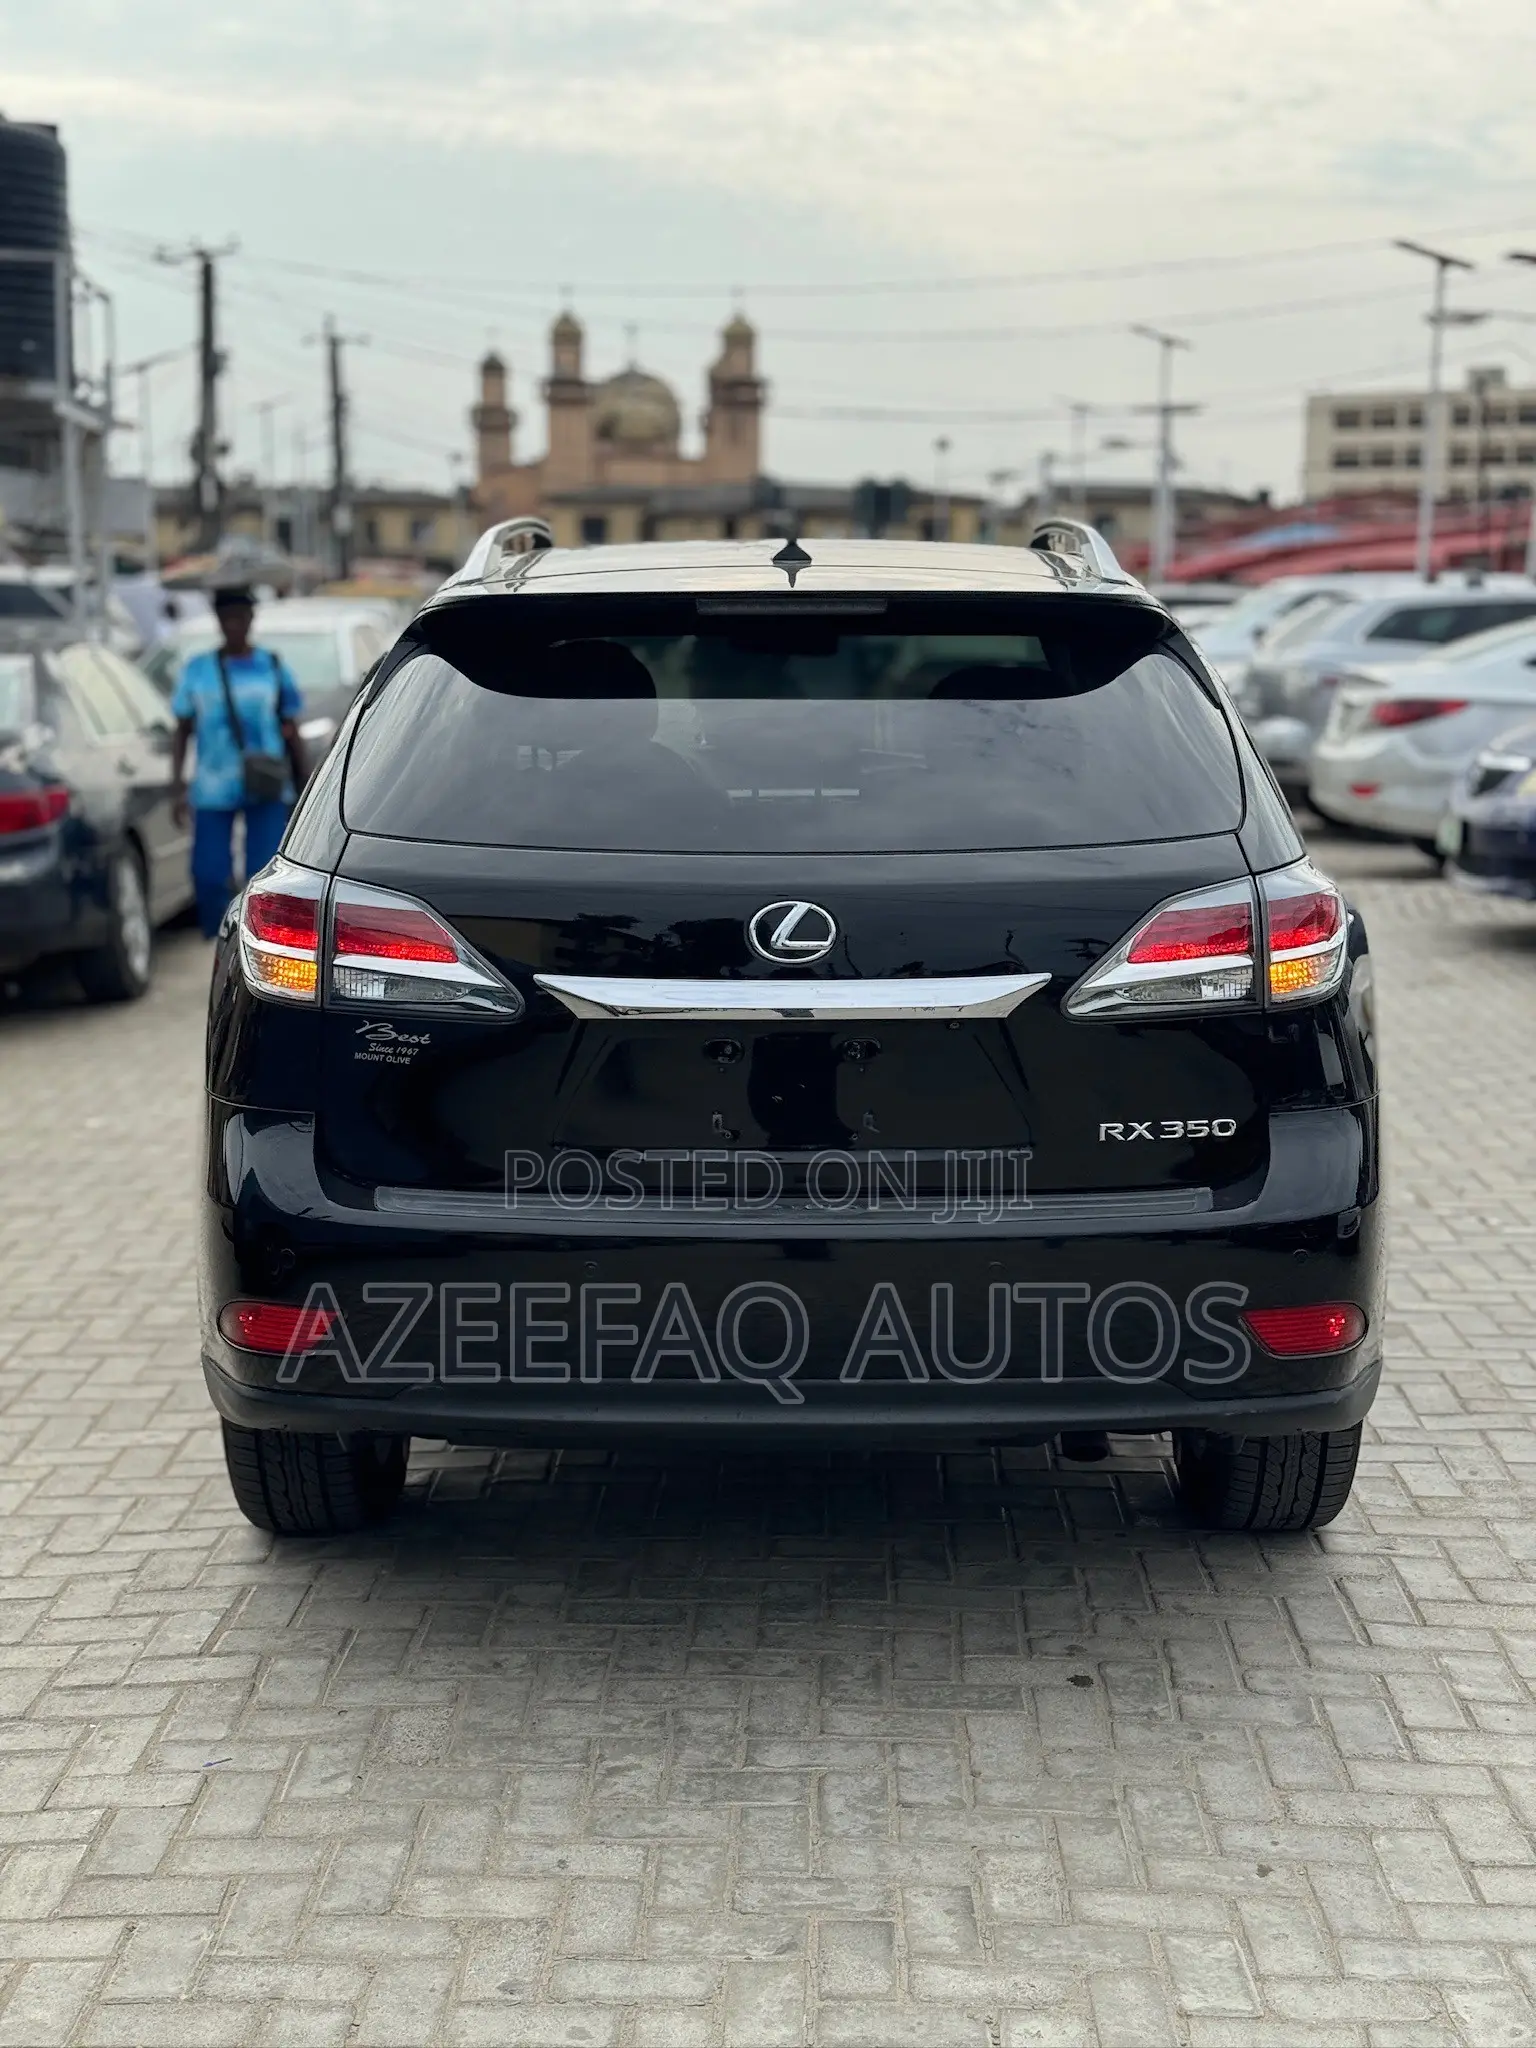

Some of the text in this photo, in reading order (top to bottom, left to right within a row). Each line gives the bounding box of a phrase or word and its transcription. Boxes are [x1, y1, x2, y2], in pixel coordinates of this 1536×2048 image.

[355, 1020, 431, 1044] Best
[368, 1042, 394, 1053] Since
[354, 1051, 411, 1064] MOUNT OLIVE
[1099, 1118, 1237, 1141] RX 350
